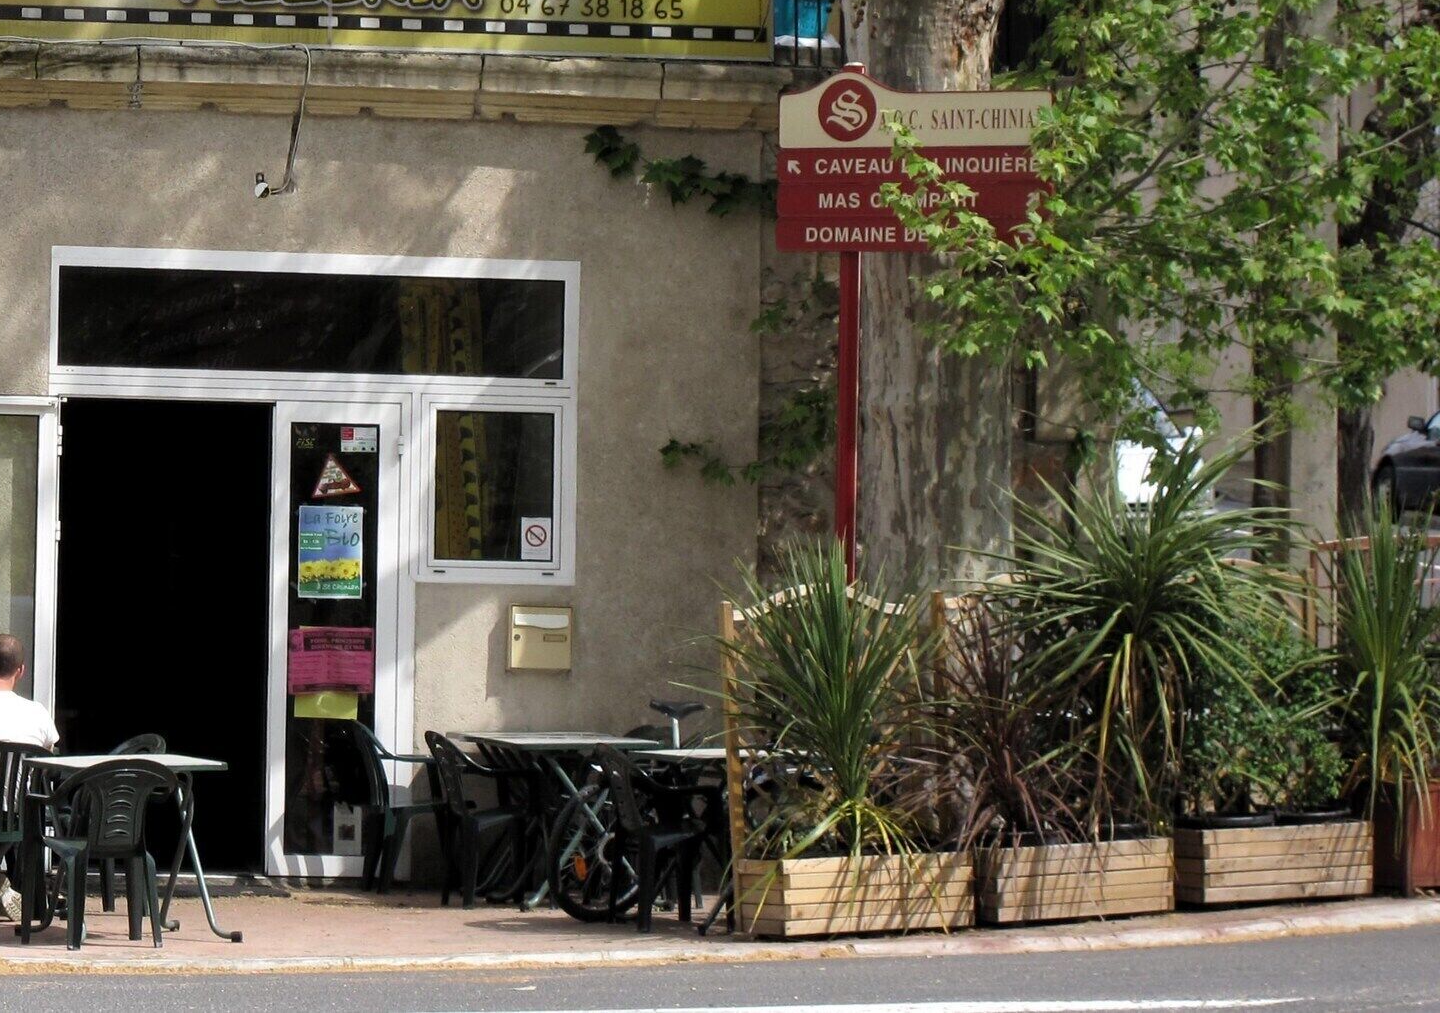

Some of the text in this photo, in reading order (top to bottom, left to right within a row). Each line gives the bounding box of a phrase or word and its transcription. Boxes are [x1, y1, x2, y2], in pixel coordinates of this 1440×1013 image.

[931, 108, 1040, 130] SAINT-CHINIA
[814, 158, 894, 174] CAVEAU
[935, 153, 1039, 174] INQUIÈRE
[818, 192, 861, 209] MAS
[805, 226, 897, 243] DOMAINE
